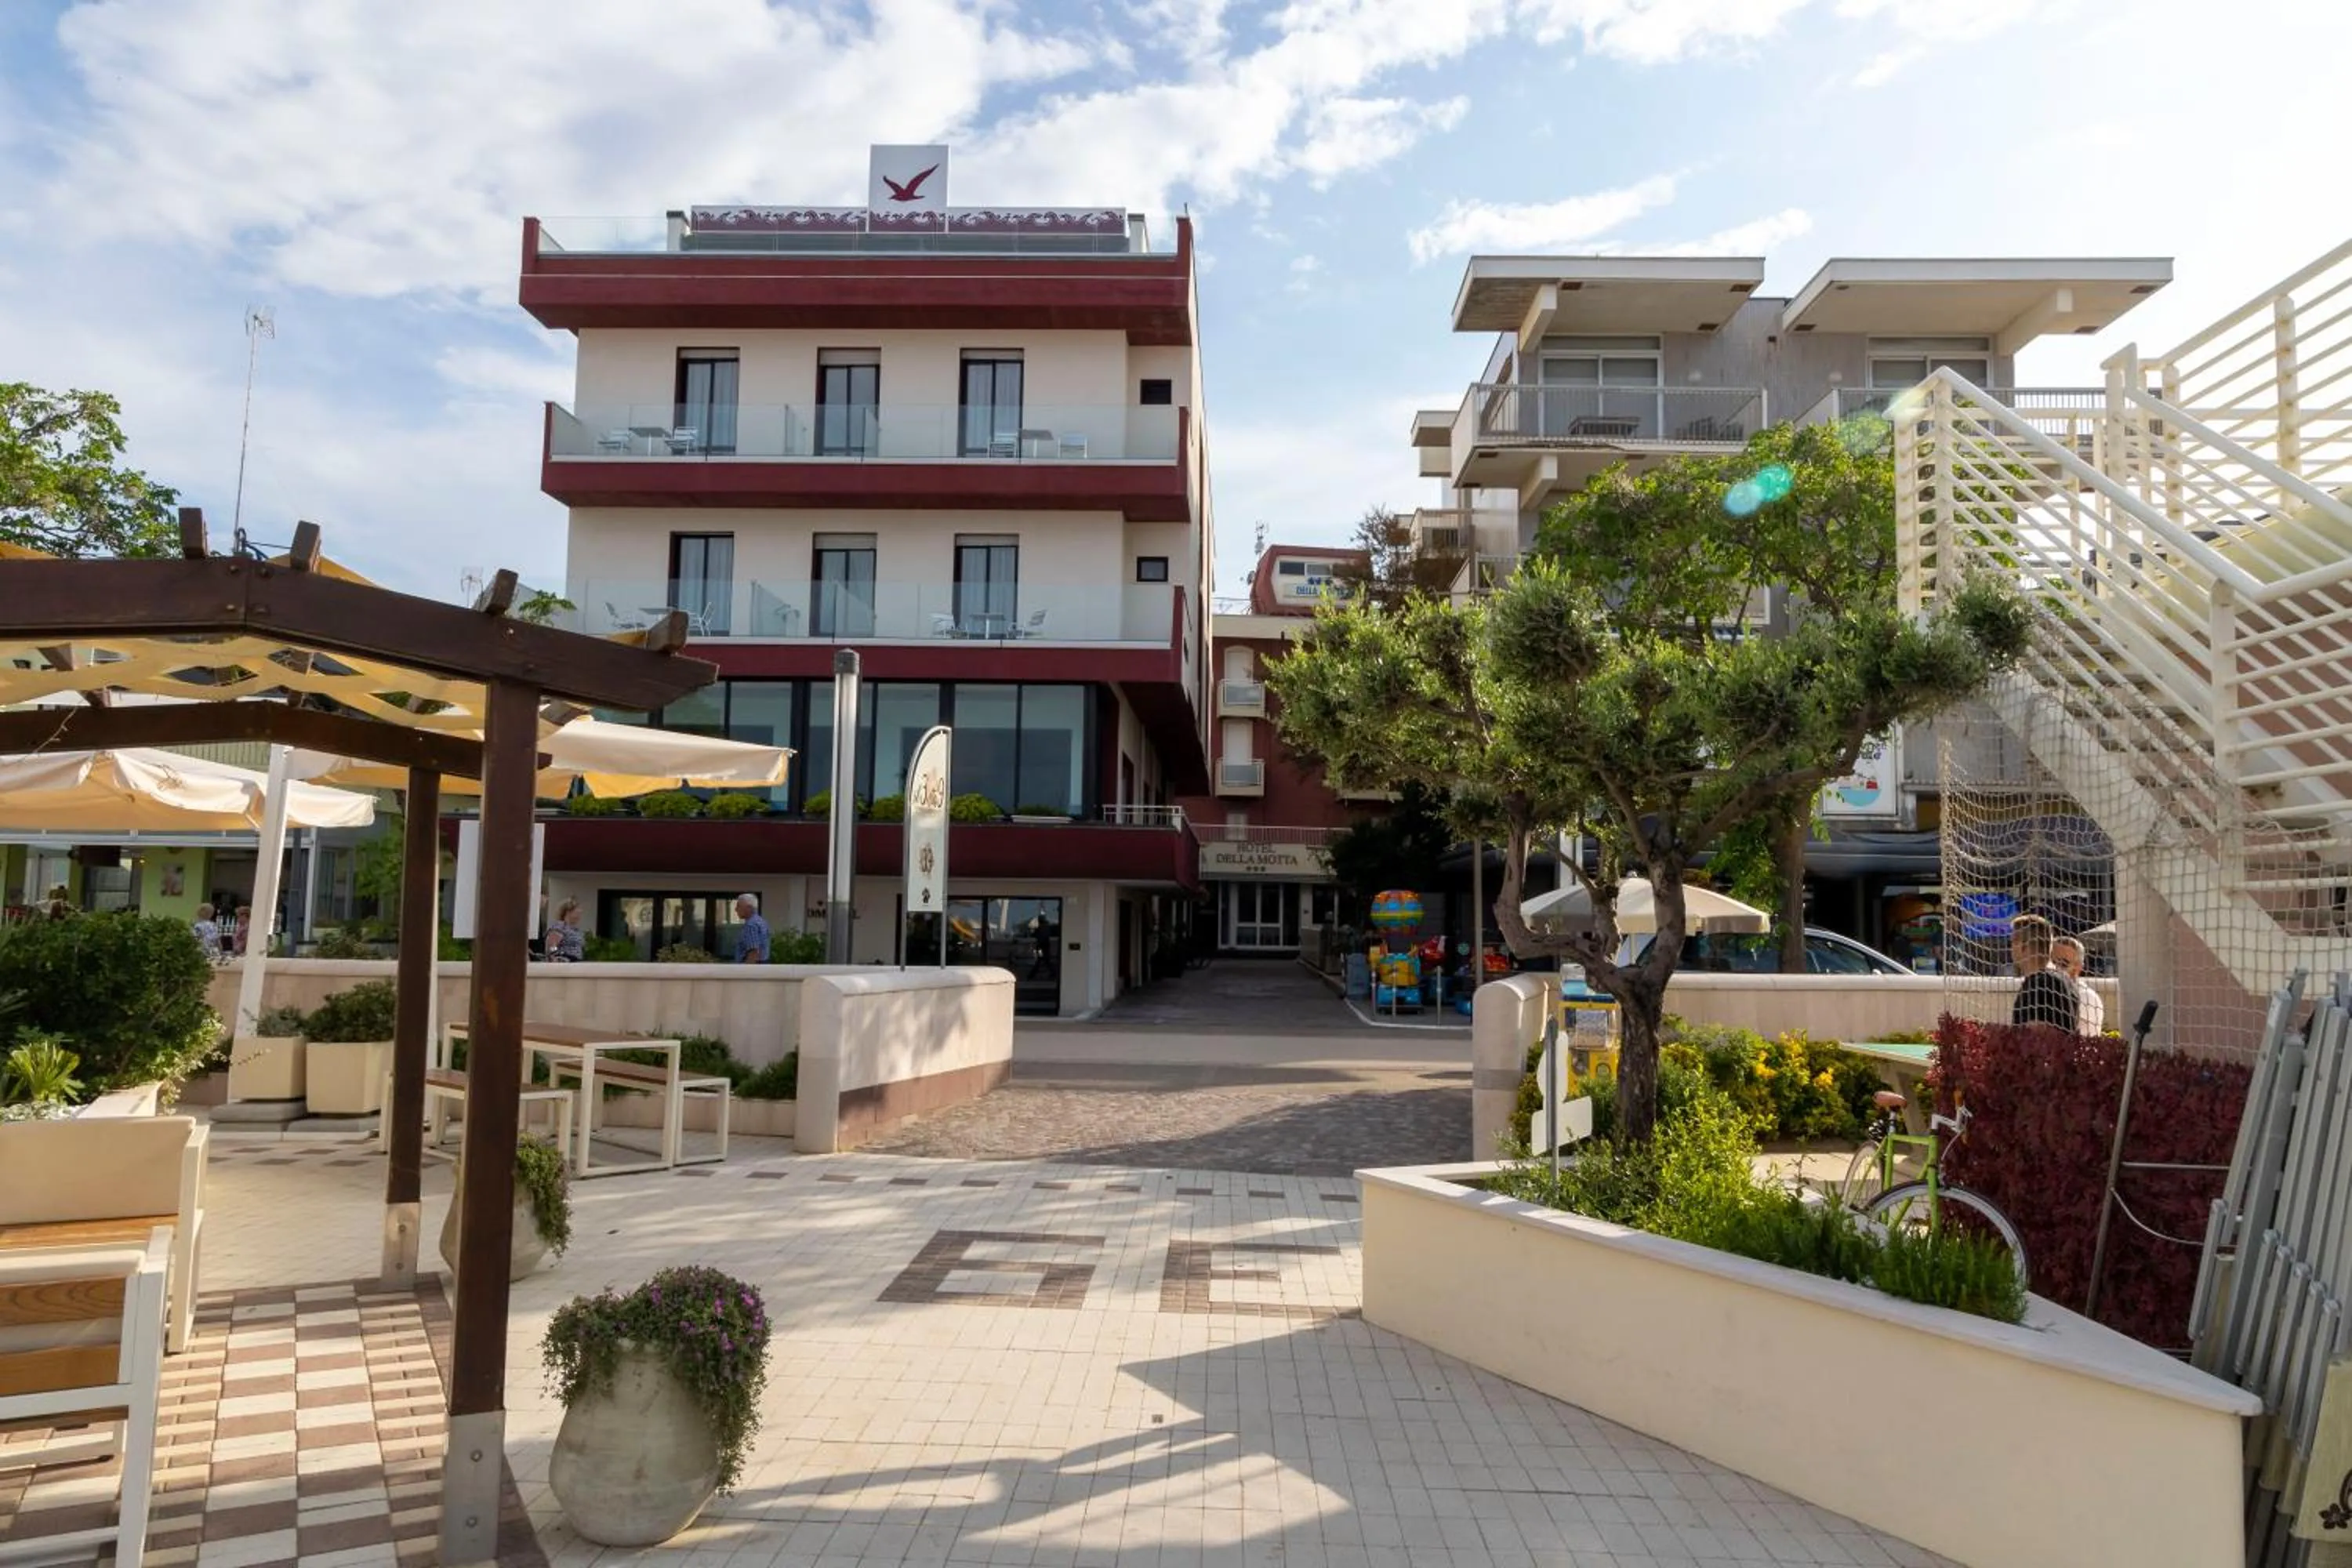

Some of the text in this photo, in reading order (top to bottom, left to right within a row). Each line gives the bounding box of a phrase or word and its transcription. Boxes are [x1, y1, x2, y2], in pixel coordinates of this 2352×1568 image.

[1236, 842, 1276, 853] HOTEL
[1216, 853, 1298, 865] DELLA MOTTA
